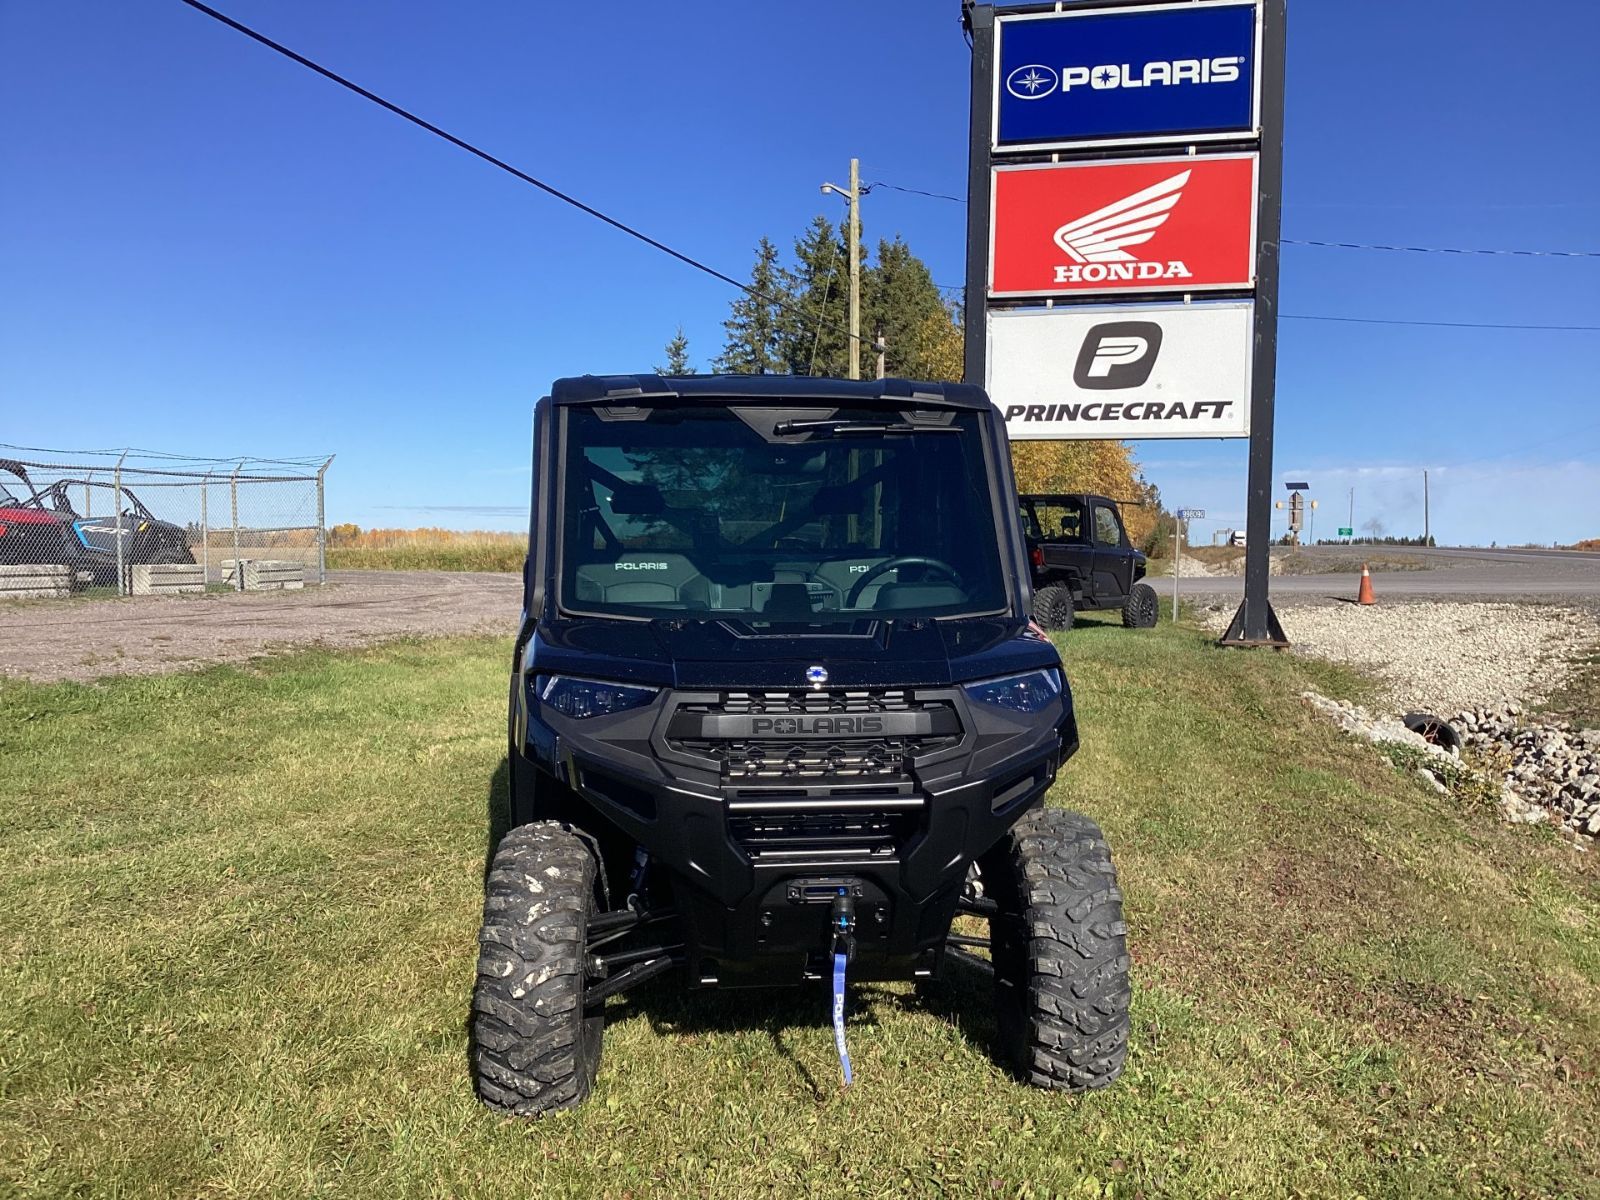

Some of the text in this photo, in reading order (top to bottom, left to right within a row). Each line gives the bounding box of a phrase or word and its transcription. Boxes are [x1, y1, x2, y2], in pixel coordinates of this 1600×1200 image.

[1053, 260, 1193, 283] HONDA
[1004, 400, 1233, 422] PRINCECRAFT
[614, 562, 668, 571] POLARIS
[752, 716, 883, 734] POLARIS
